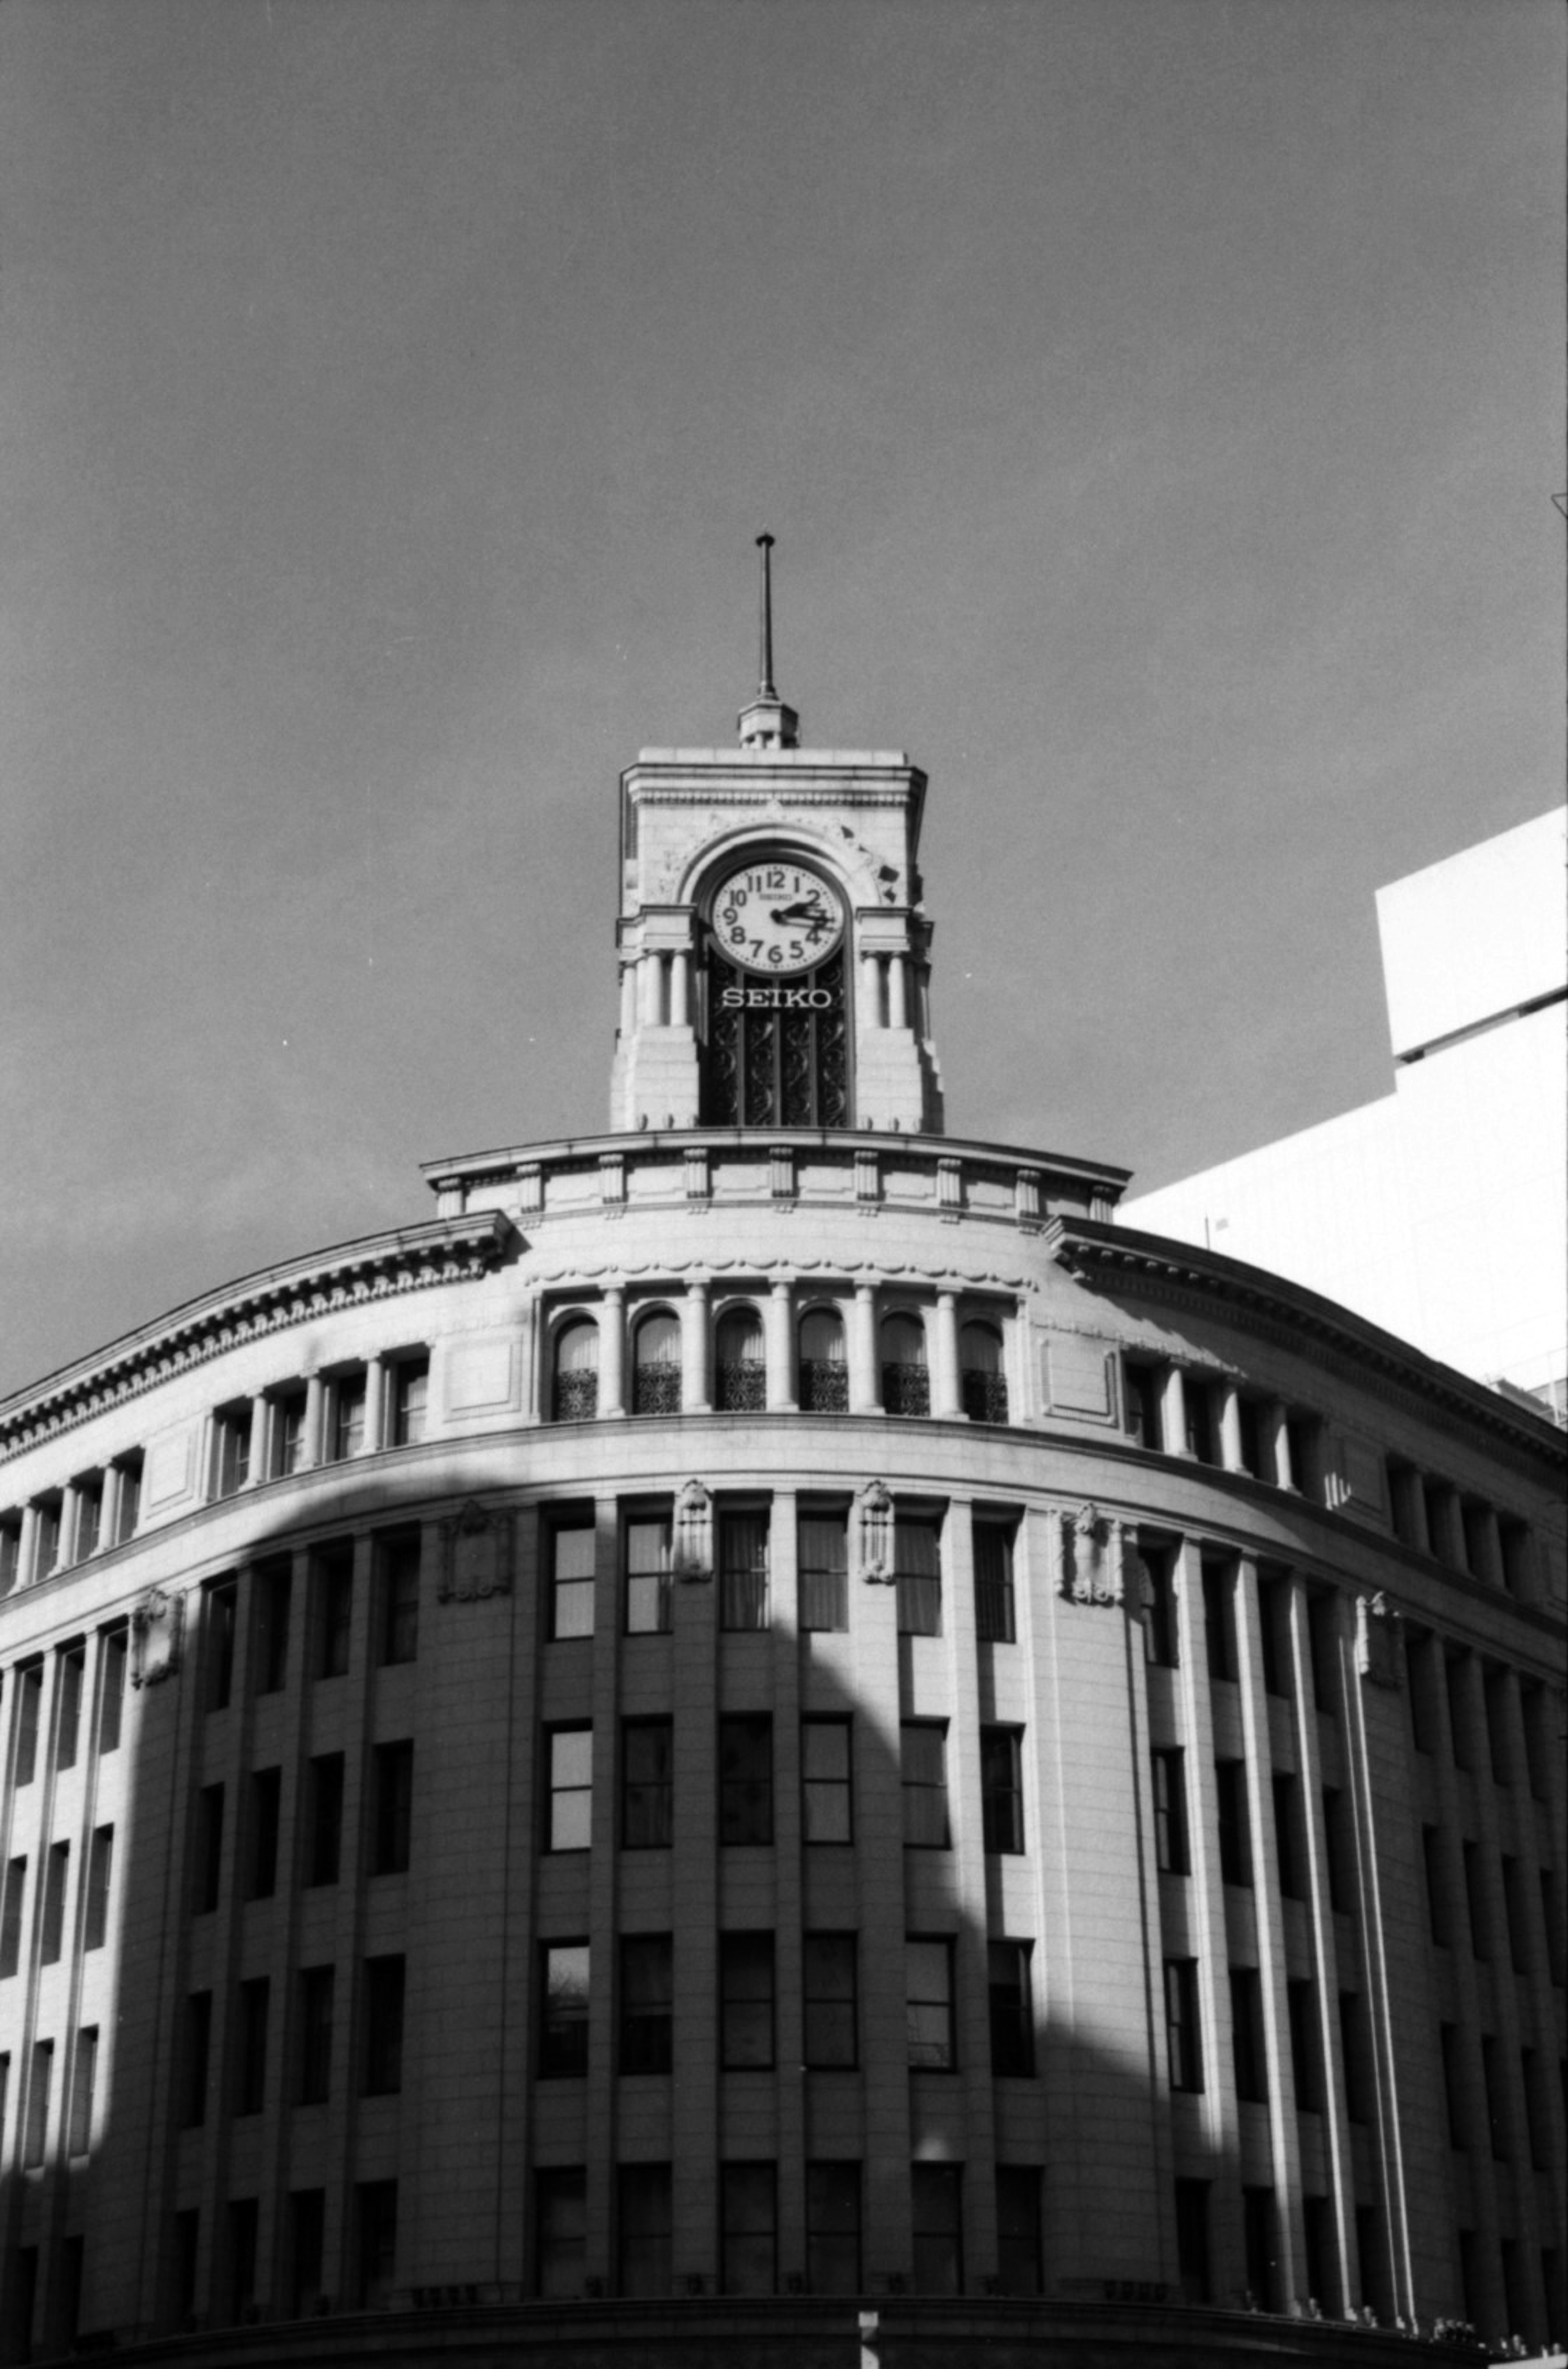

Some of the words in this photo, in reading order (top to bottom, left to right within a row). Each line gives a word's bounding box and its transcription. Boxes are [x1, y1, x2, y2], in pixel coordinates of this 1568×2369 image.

[748, 875, 762, 892] 11
[767, 871, 785, 888] 12
[794, 876, 800, 893] 1
[730, 889, 747, 907] 10
[807, 889, 820, 907] 2
[723, 908, 737, 925] 9
[731, 927, 745, 944] 8
[806, 926, 822, 945] 4
[749, 940, 764, 958] 7
[768, 945, 782, 963] 6
[790, 941, 804, 958] 5
[722, 989, 831, 1008] SEIKO
